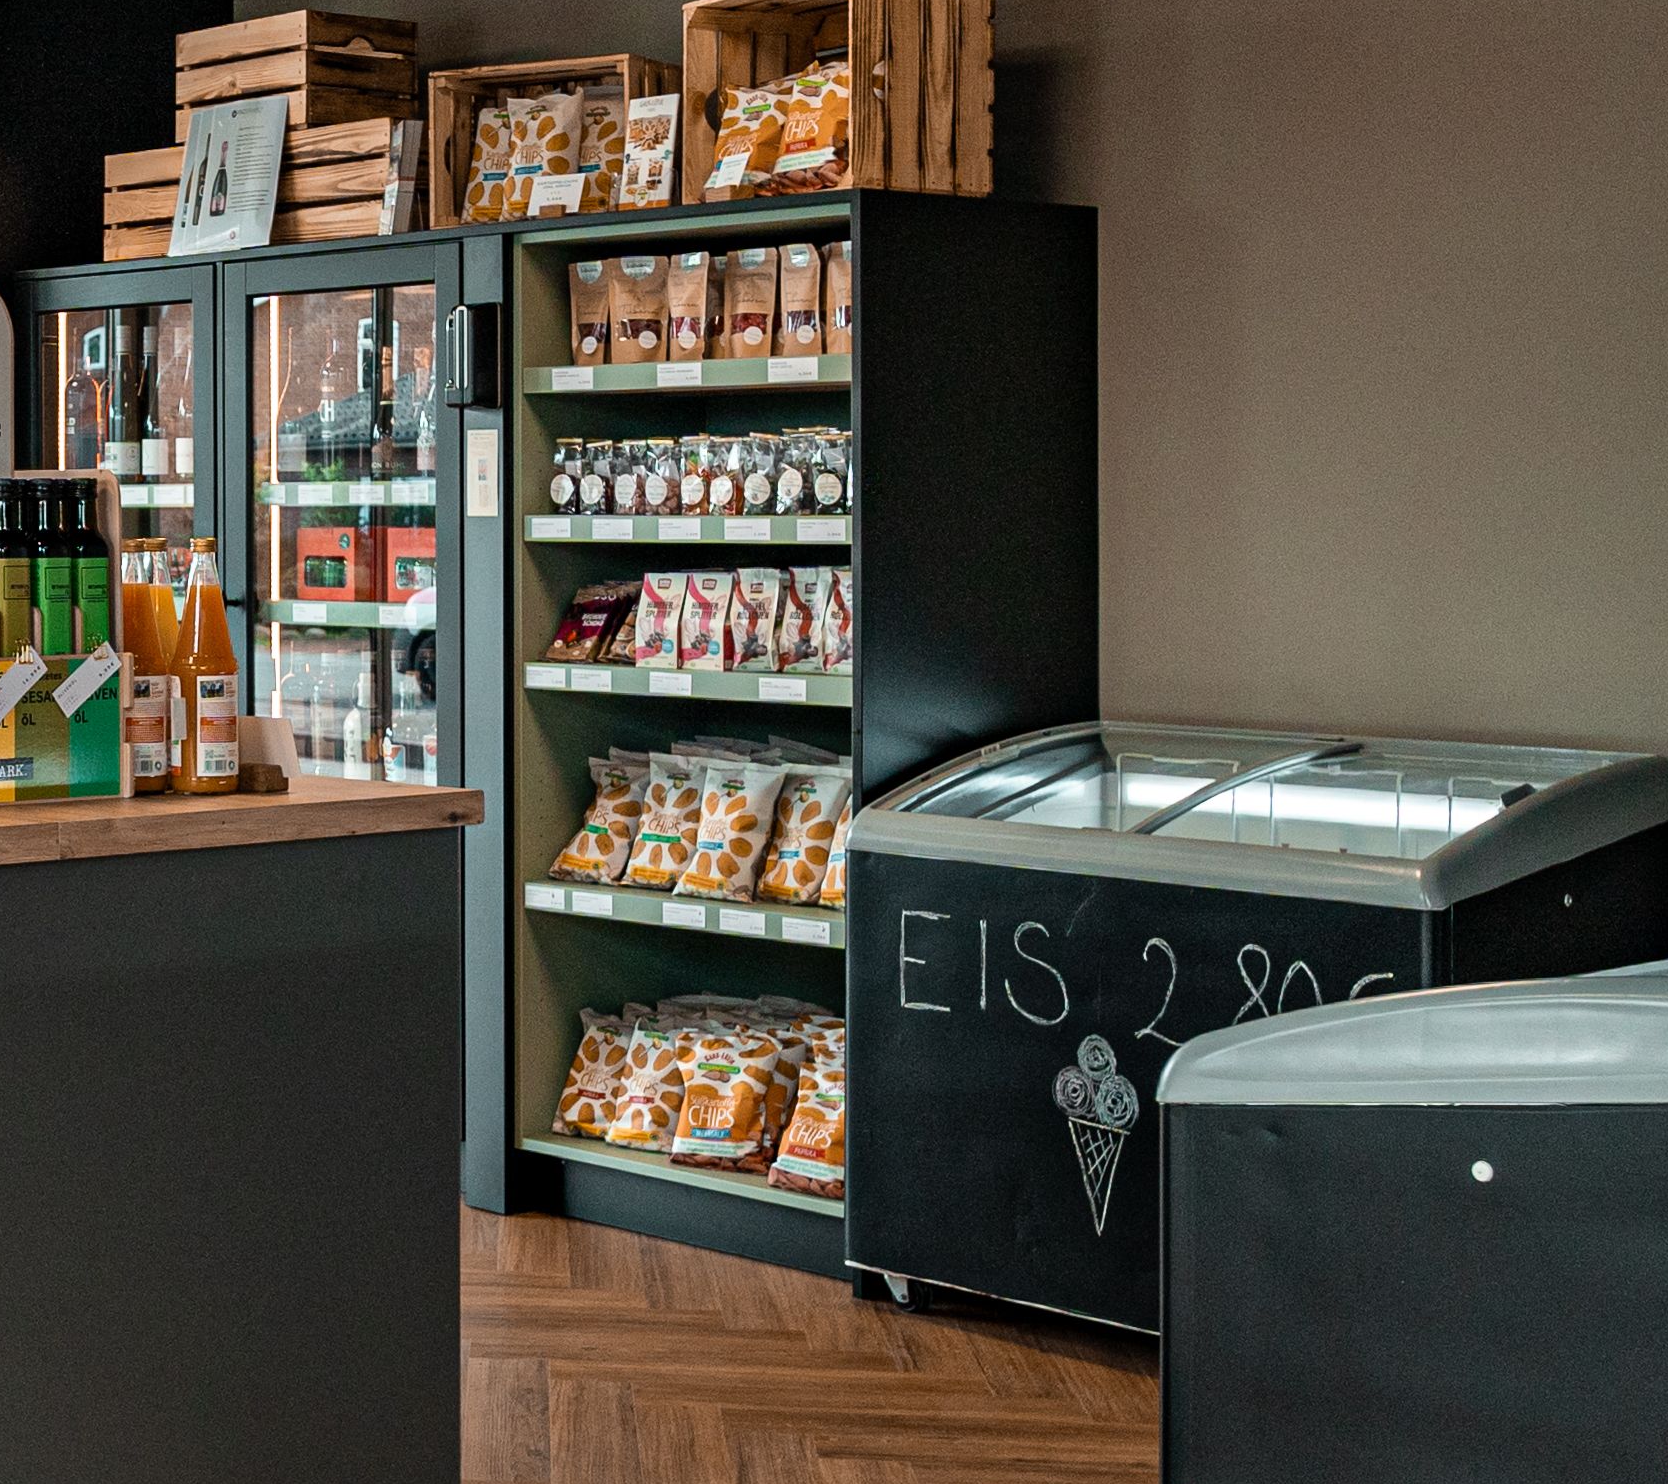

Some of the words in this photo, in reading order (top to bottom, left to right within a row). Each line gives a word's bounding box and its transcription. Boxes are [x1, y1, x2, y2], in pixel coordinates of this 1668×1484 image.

[22, 690, 55, 705] SESA
[22, 713, 37, 727] ÖL
[74, 710, 89, 724] ÖL
[648, 818, 681, 835] CHIPS
[901, 908, 1069, 1025] EIS
[688, 1105, 736, 1129] CHIPS
[788, 1122, 833, 1149] CHIPS
